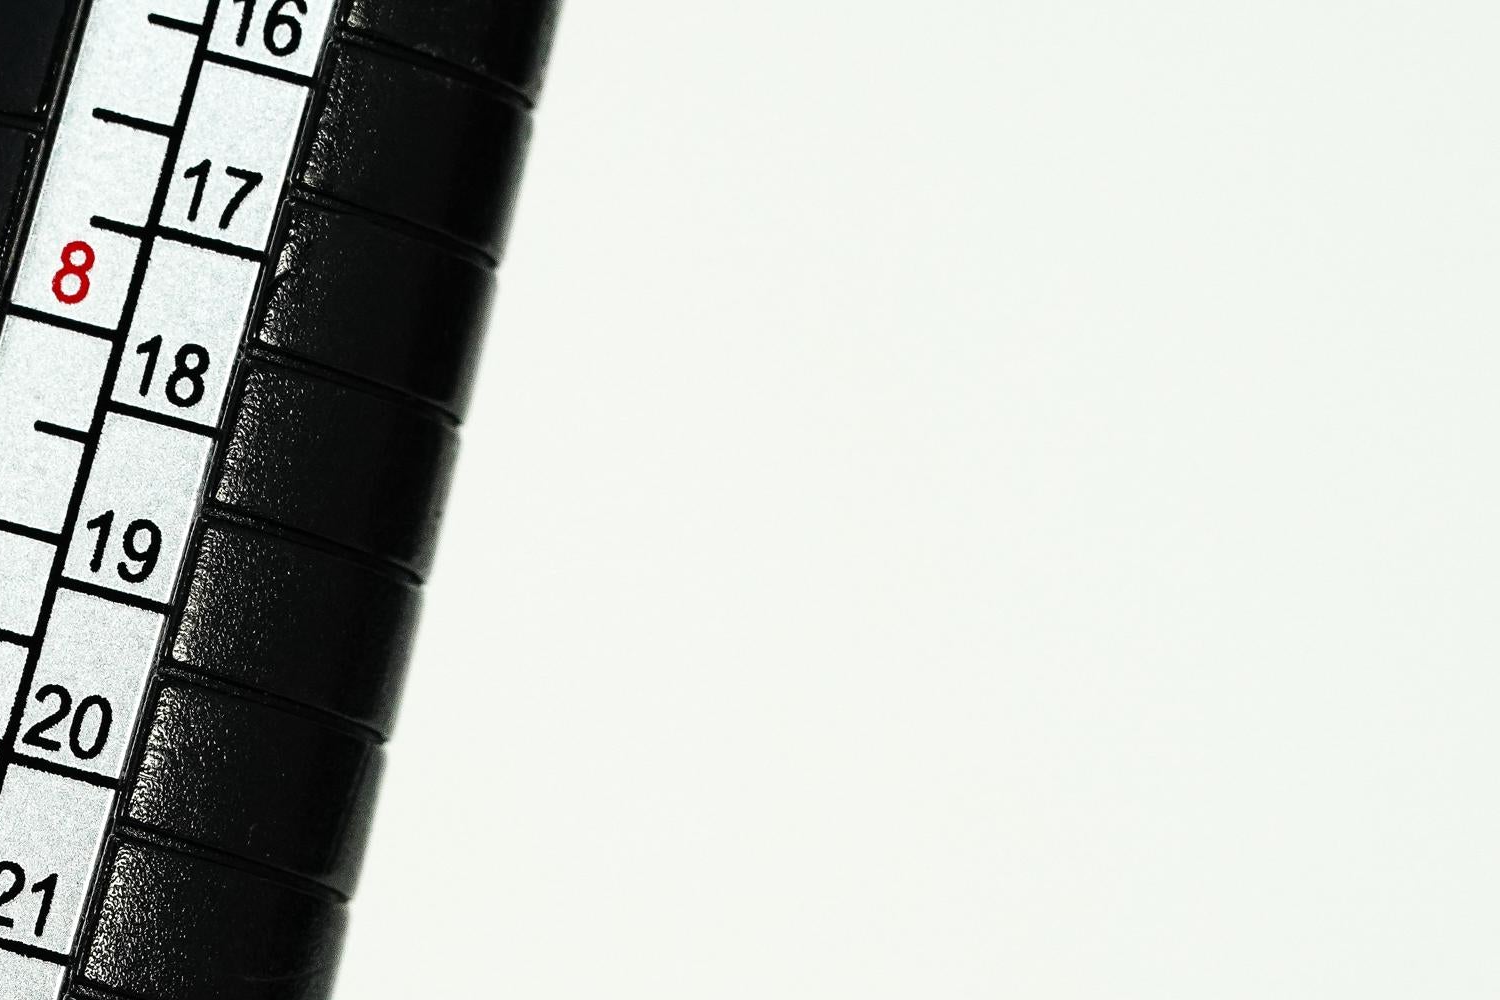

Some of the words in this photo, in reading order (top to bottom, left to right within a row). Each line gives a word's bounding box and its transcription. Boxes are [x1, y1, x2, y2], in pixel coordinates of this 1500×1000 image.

[231, 0, 308, 57] 16
[182, 158, 264, 230] 17
[50, 239, 97, 306] 8
[134, 333, 212, 410] 18
[85, 508, 164, 585] 19
[20, 682, 115, 762] 20
